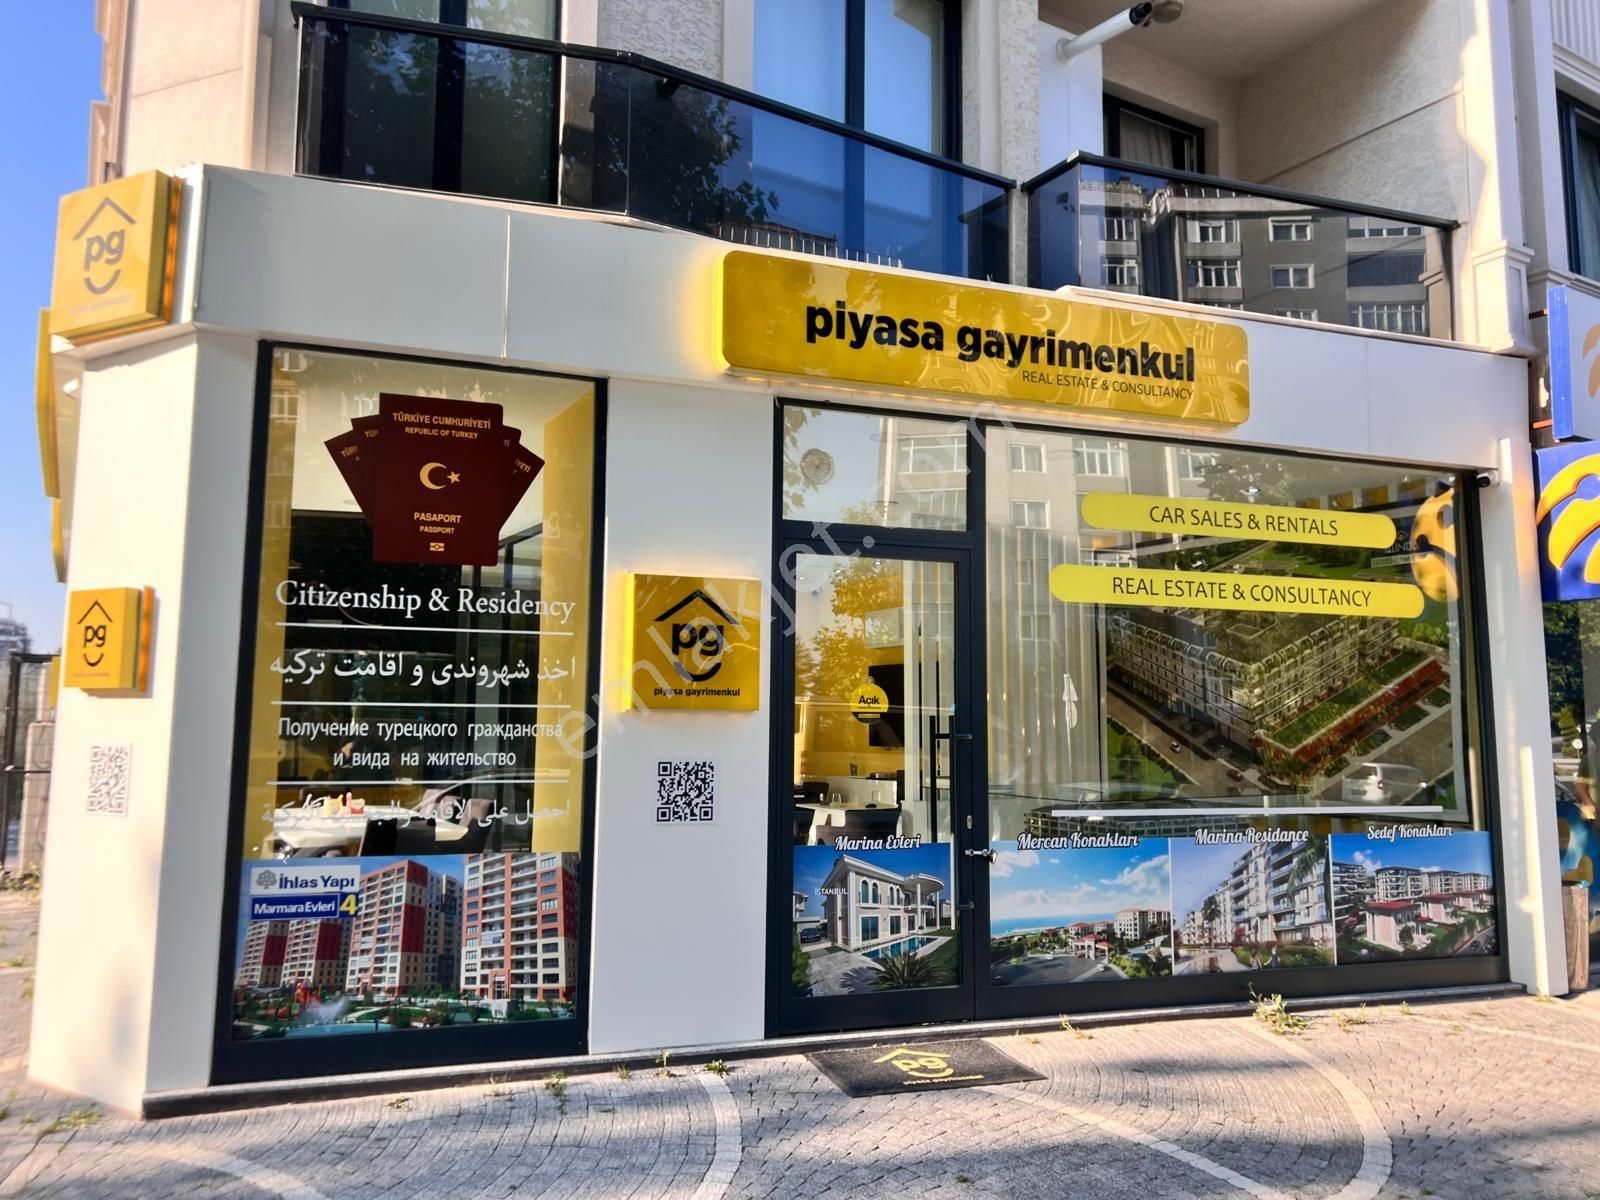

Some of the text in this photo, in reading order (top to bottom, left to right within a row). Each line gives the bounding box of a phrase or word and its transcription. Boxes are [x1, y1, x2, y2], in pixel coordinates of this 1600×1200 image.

[84, 229, 125, 272] pg
[806, 300, 1196, 382] piyasa gayrimenkul
[1022, 371, 1194, 400] REAL ESTATE & CONSULTANCY
[393, 411, 491, 430] TÜRKİYE CUMHURİYETİ
[404, 427, 439, 437] REPUBLIC
[451, 431, 478, 439] TURKEY
[413, 511, 462, 524] PASAPORT
[1149, 506, 1338, 537] CAR SALES & RENTALS
[419, 525, 455, 535] PASSPORT
[275, 579, 576, 625] Citizenship & Residency
[1112, 577, 1372, 608] REAL ESTATE & CONSULTANCY
[83, 624, 107, 649] pg
[672, 623, 724, 657] pg
[334, 651, 403, 677] اقامت
[431, 655, 530, 688] شهروندی
[537, 656, 576, 681] اخذ
[653, 687, 740, 697] piyasa gayrimenkul
[279, 717, 563, 742] Получение турецкого гражданства
[333, 751, 516, 769] и вида на жительство
[835, 833, 921, 852] Marina Evleri
[1018, 831, 1139, 851] Mercan Konakları
[1194, 828, 1309, 845] Marina Residance
[1366, 824, 1453, 843] Sedef Konakları
[278, 874, 355, 892] İhlas Yapı
[253, 894, 357, 916] Marmara Evleri 4
